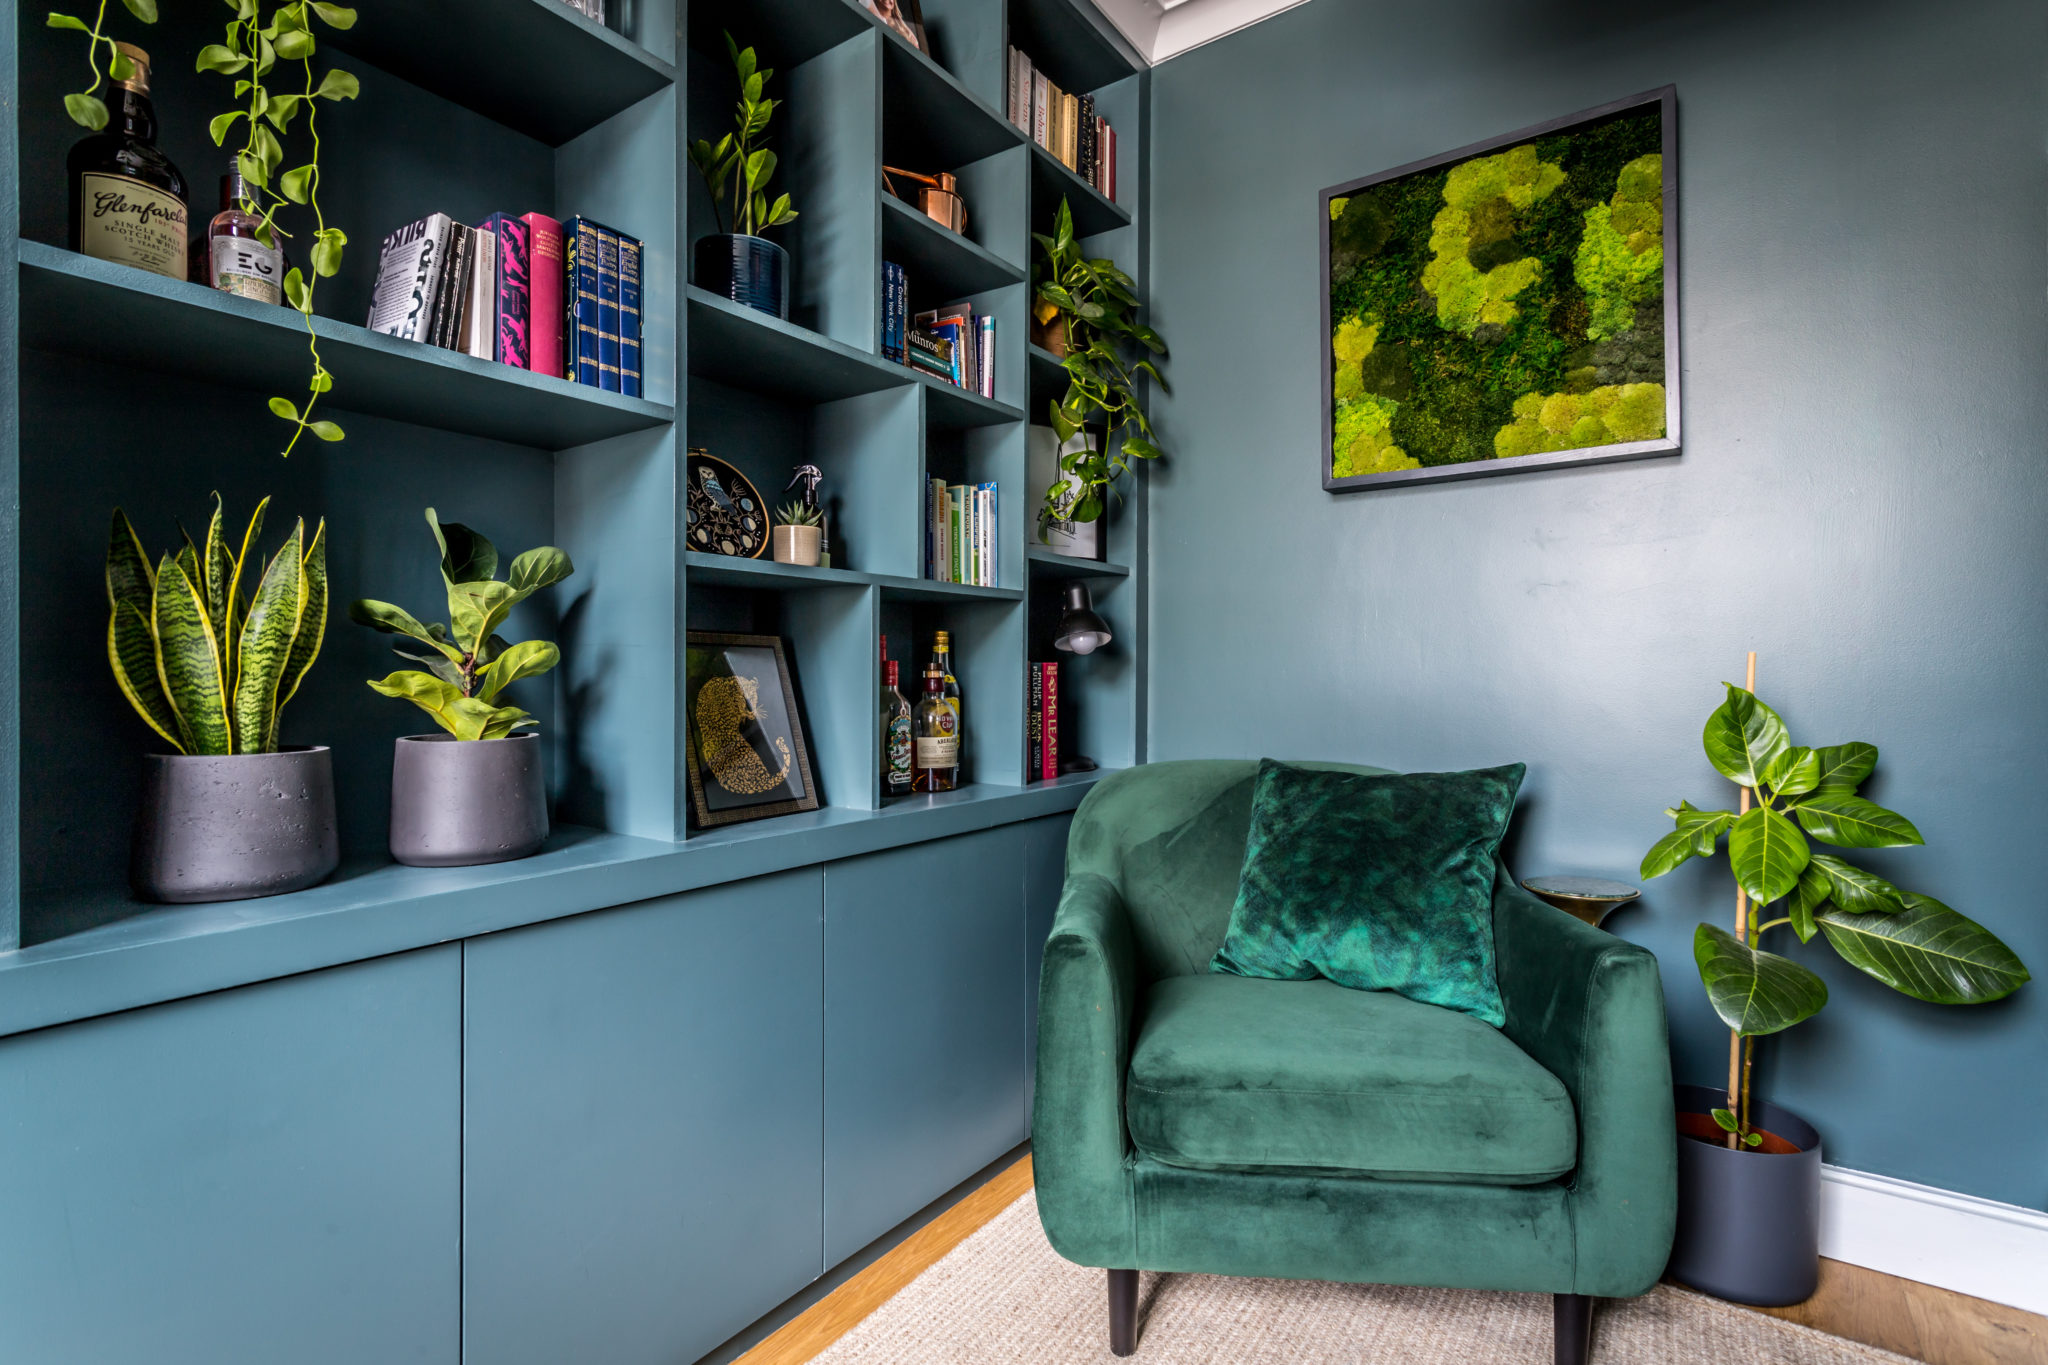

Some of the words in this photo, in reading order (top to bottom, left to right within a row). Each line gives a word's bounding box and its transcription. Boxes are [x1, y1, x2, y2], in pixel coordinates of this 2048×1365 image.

[1036, 105, 1046, 147] Behave
[93, 191, 187, 226] Glenfarcla
[104, 225, 151, 241] SCOTCH
[114, 219, 155, 236] SINGLE
[138, 240, 160, 251] YEARS
[906, 330, 939, 353] Munros
[1048, 720, 1056, 757] LEAR
